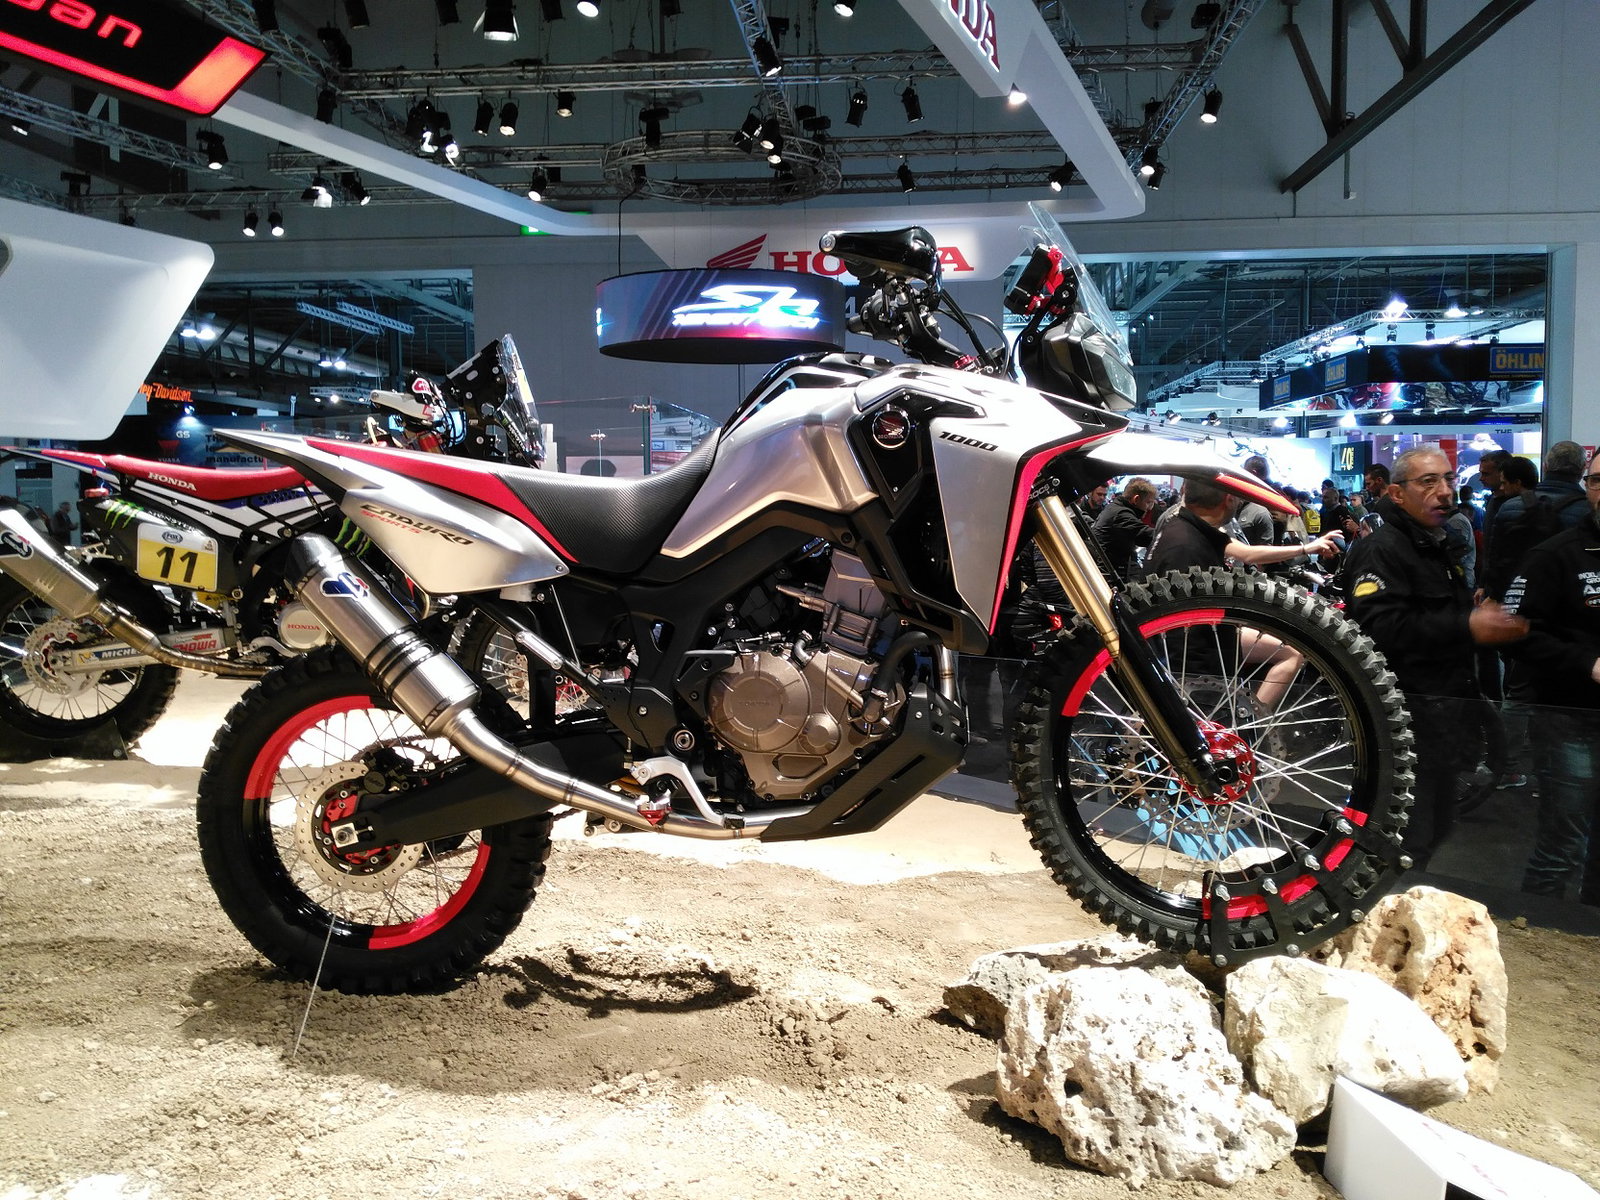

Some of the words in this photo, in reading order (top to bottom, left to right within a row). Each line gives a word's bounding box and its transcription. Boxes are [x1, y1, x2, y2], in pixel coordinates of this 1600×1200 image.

[8, 0, 143, 49] an
[947, 0, 1001, 74] DA
[768, 246, 975, 276] HOA
[1495, 349, 1544, 370] ÖHLIN
[139, 382, 194, 403] ley-Davidson
[938, 430, 999, 452] 1000
[205, 454, 264, 464] manufactu
[147, 471, 198, 492] HONDA
[360, 509, 423, 535] SPORTS
[360, 503, 475, 546] ENDURO
[155, 545, 199, 584] 11
[287, 623, 321, 631] HONDA
[101, 648, 144, 658] MICHE
